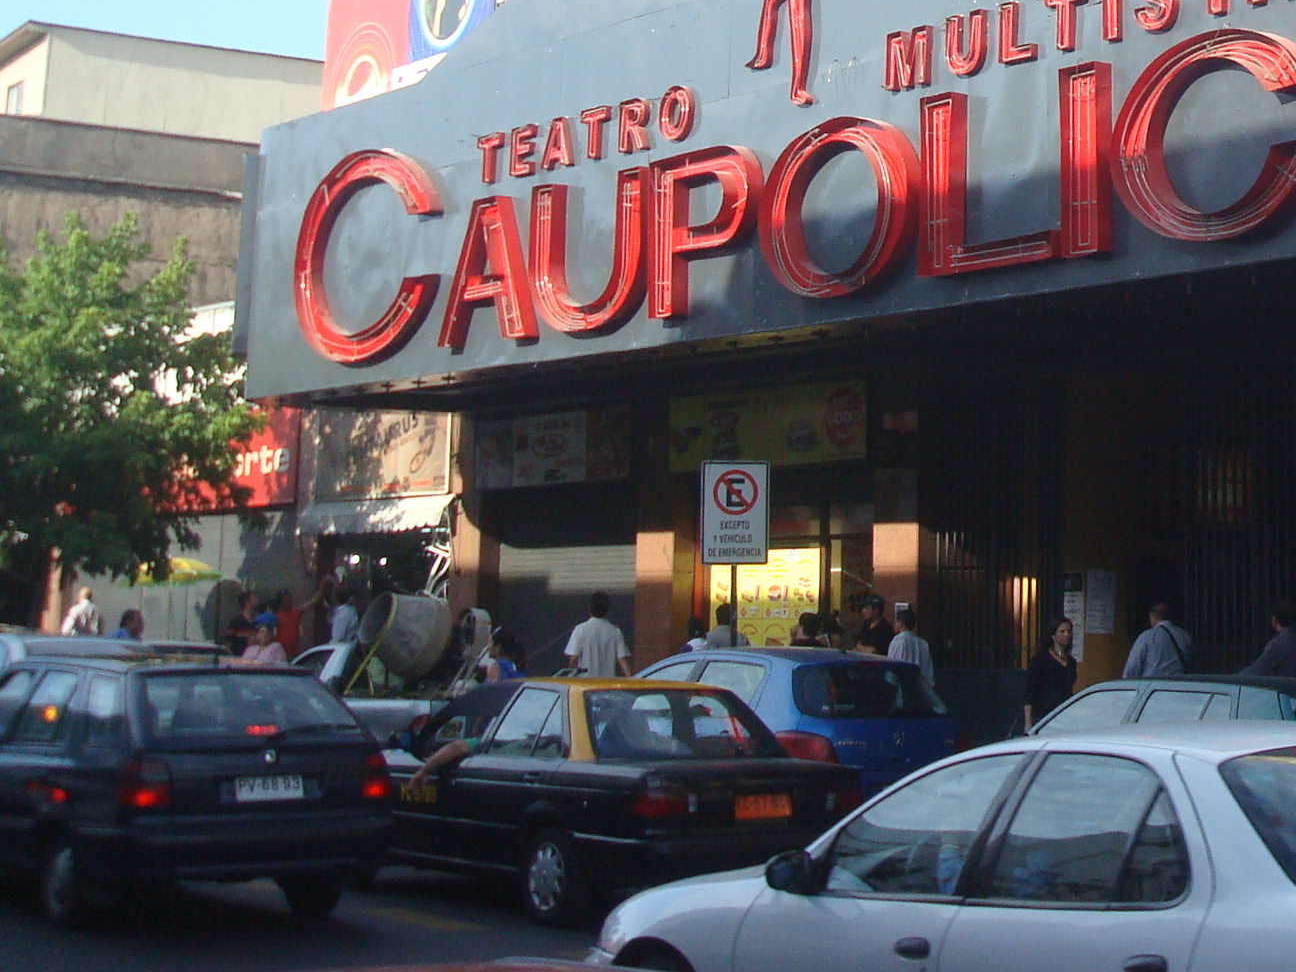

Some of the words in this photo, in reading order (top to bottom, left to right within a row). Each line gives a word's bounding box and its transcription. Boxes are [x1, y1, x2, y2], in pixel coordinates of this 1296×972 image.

[477, 85, 695, 184] TEATRO
[720, 520, 750, 530] EXCEPTO
[719, 534, 753, 543] VEHICULO
[708, 548, 716, 557] DE
[718, 548, 762, 558] EMERGENCIA
